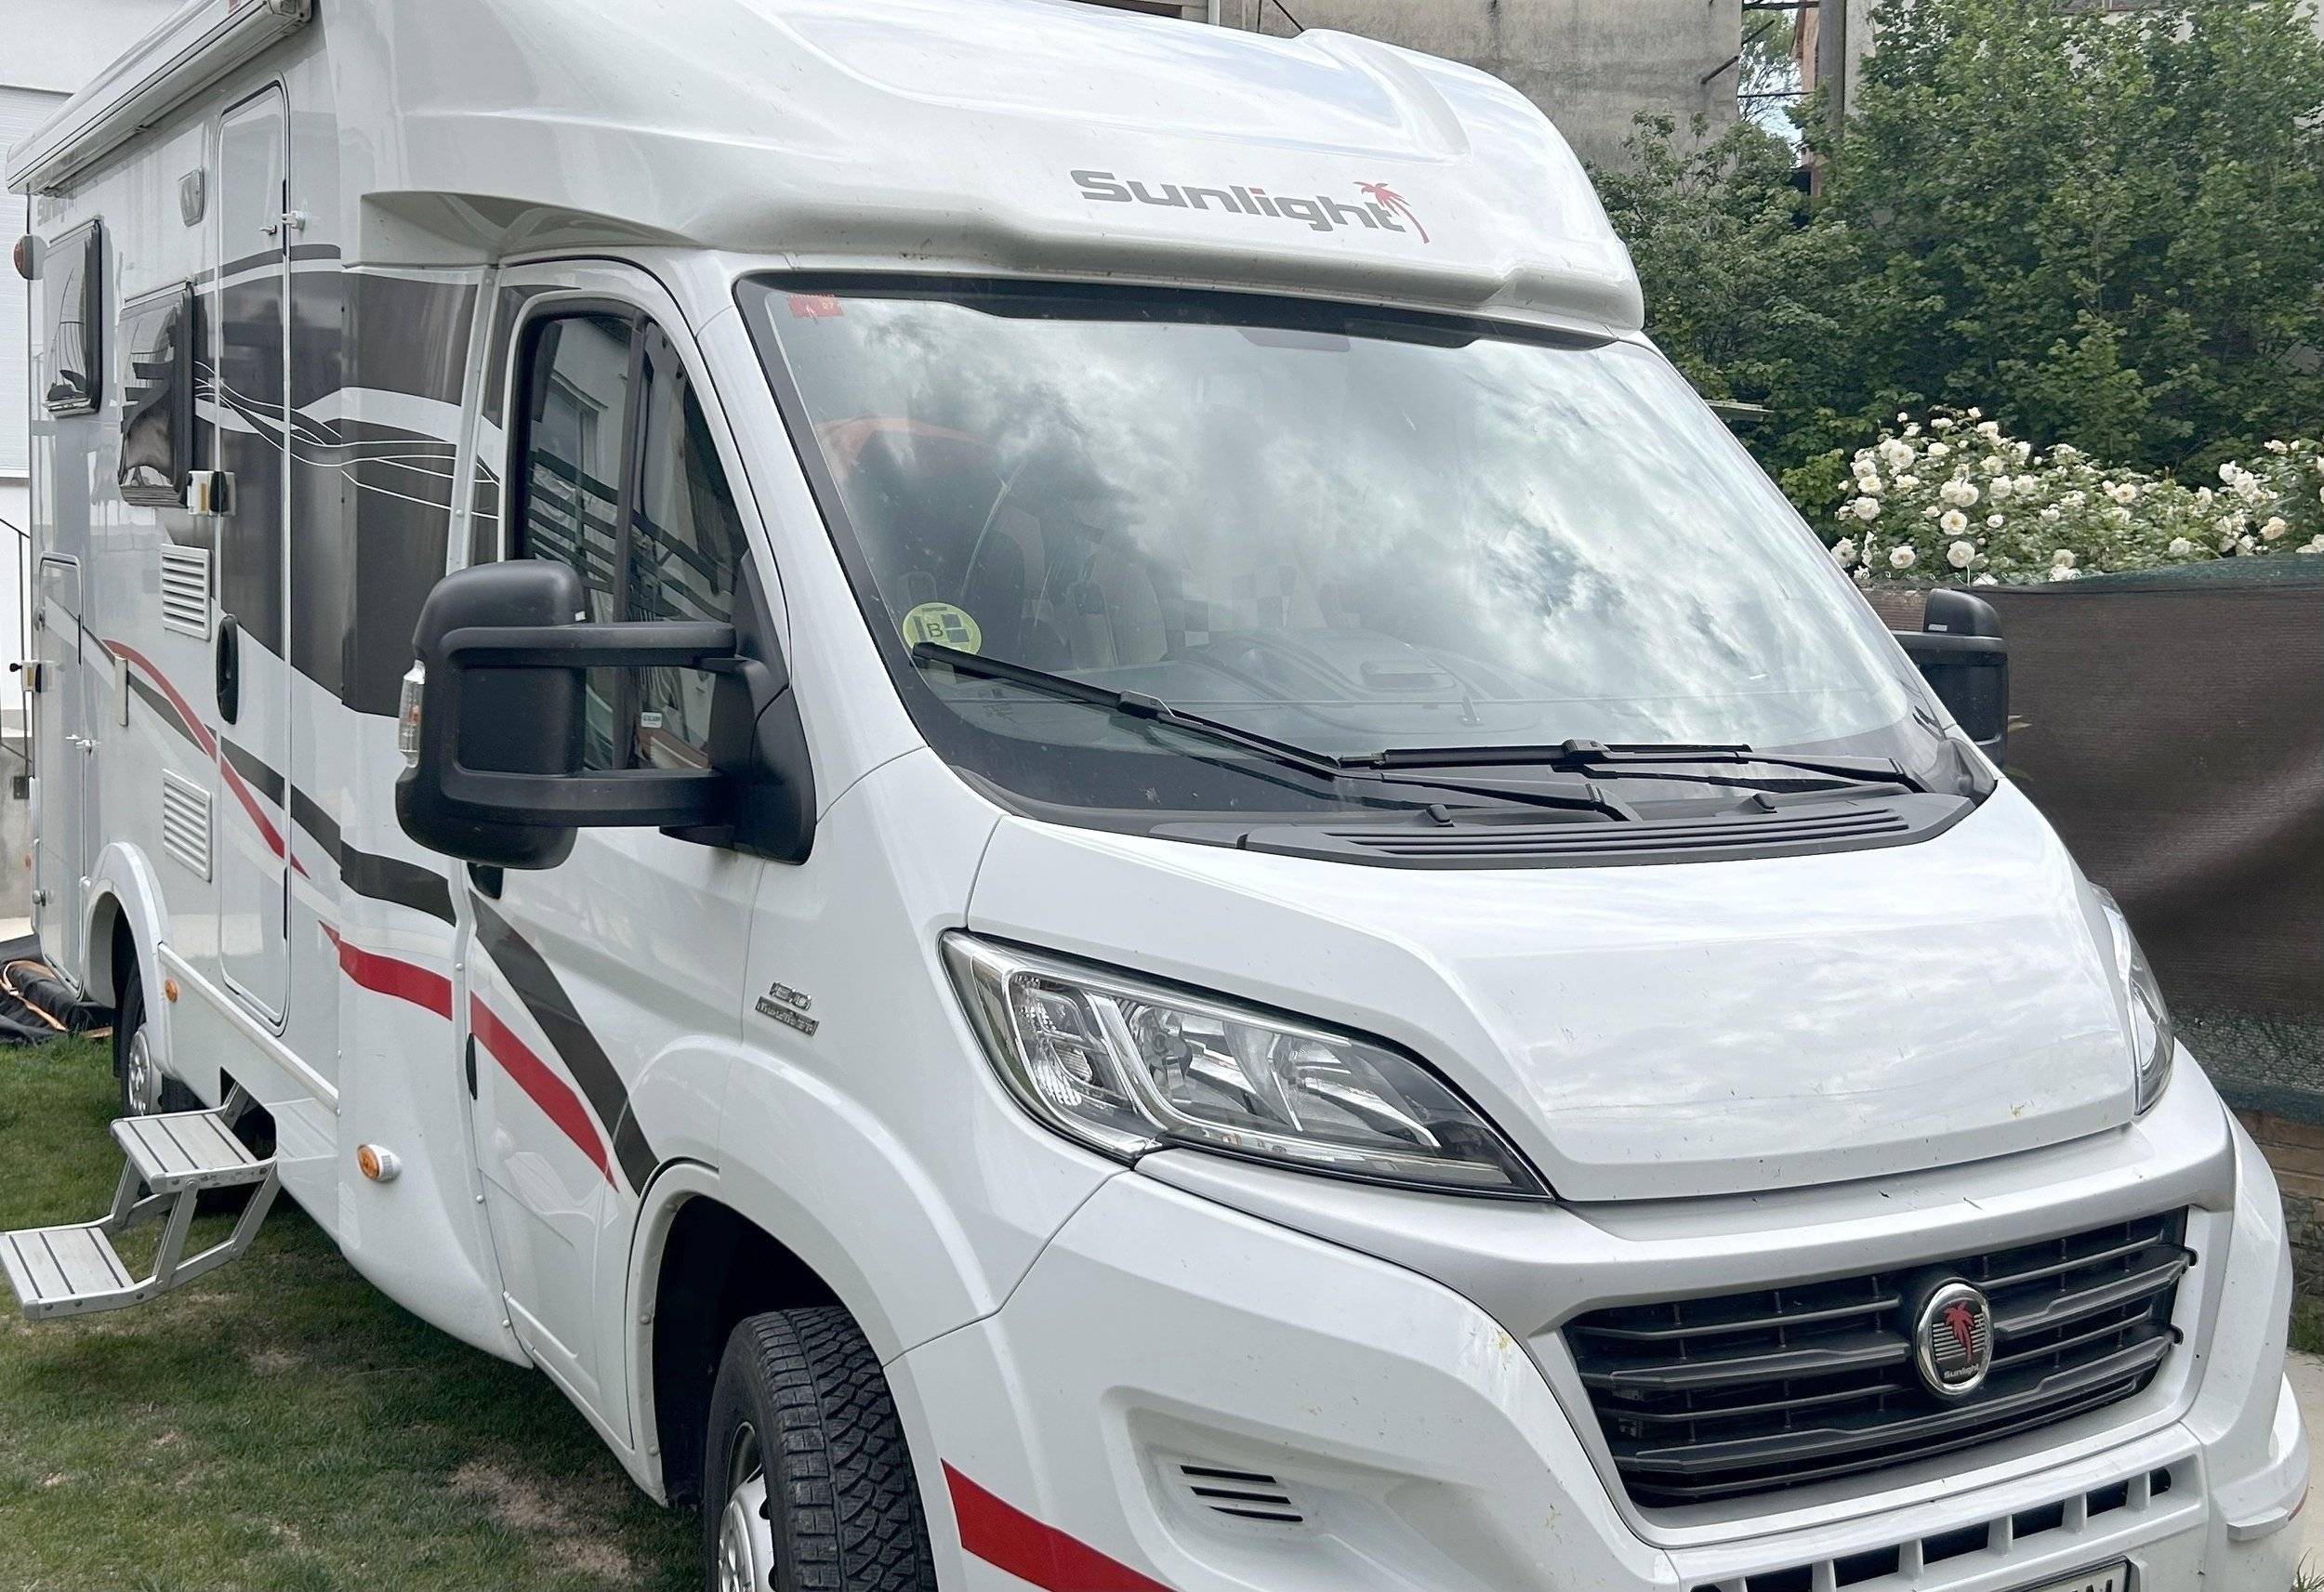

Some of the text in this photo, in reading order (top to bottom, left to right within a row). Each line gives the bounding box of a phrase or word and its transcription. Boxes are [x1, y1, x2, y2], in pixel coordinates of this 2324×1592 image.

[1070, 169, 1406, 232] Sunlight
[926, 623, 944, 638] B
[1943, 1363, 1980, 1379] Sunlight
